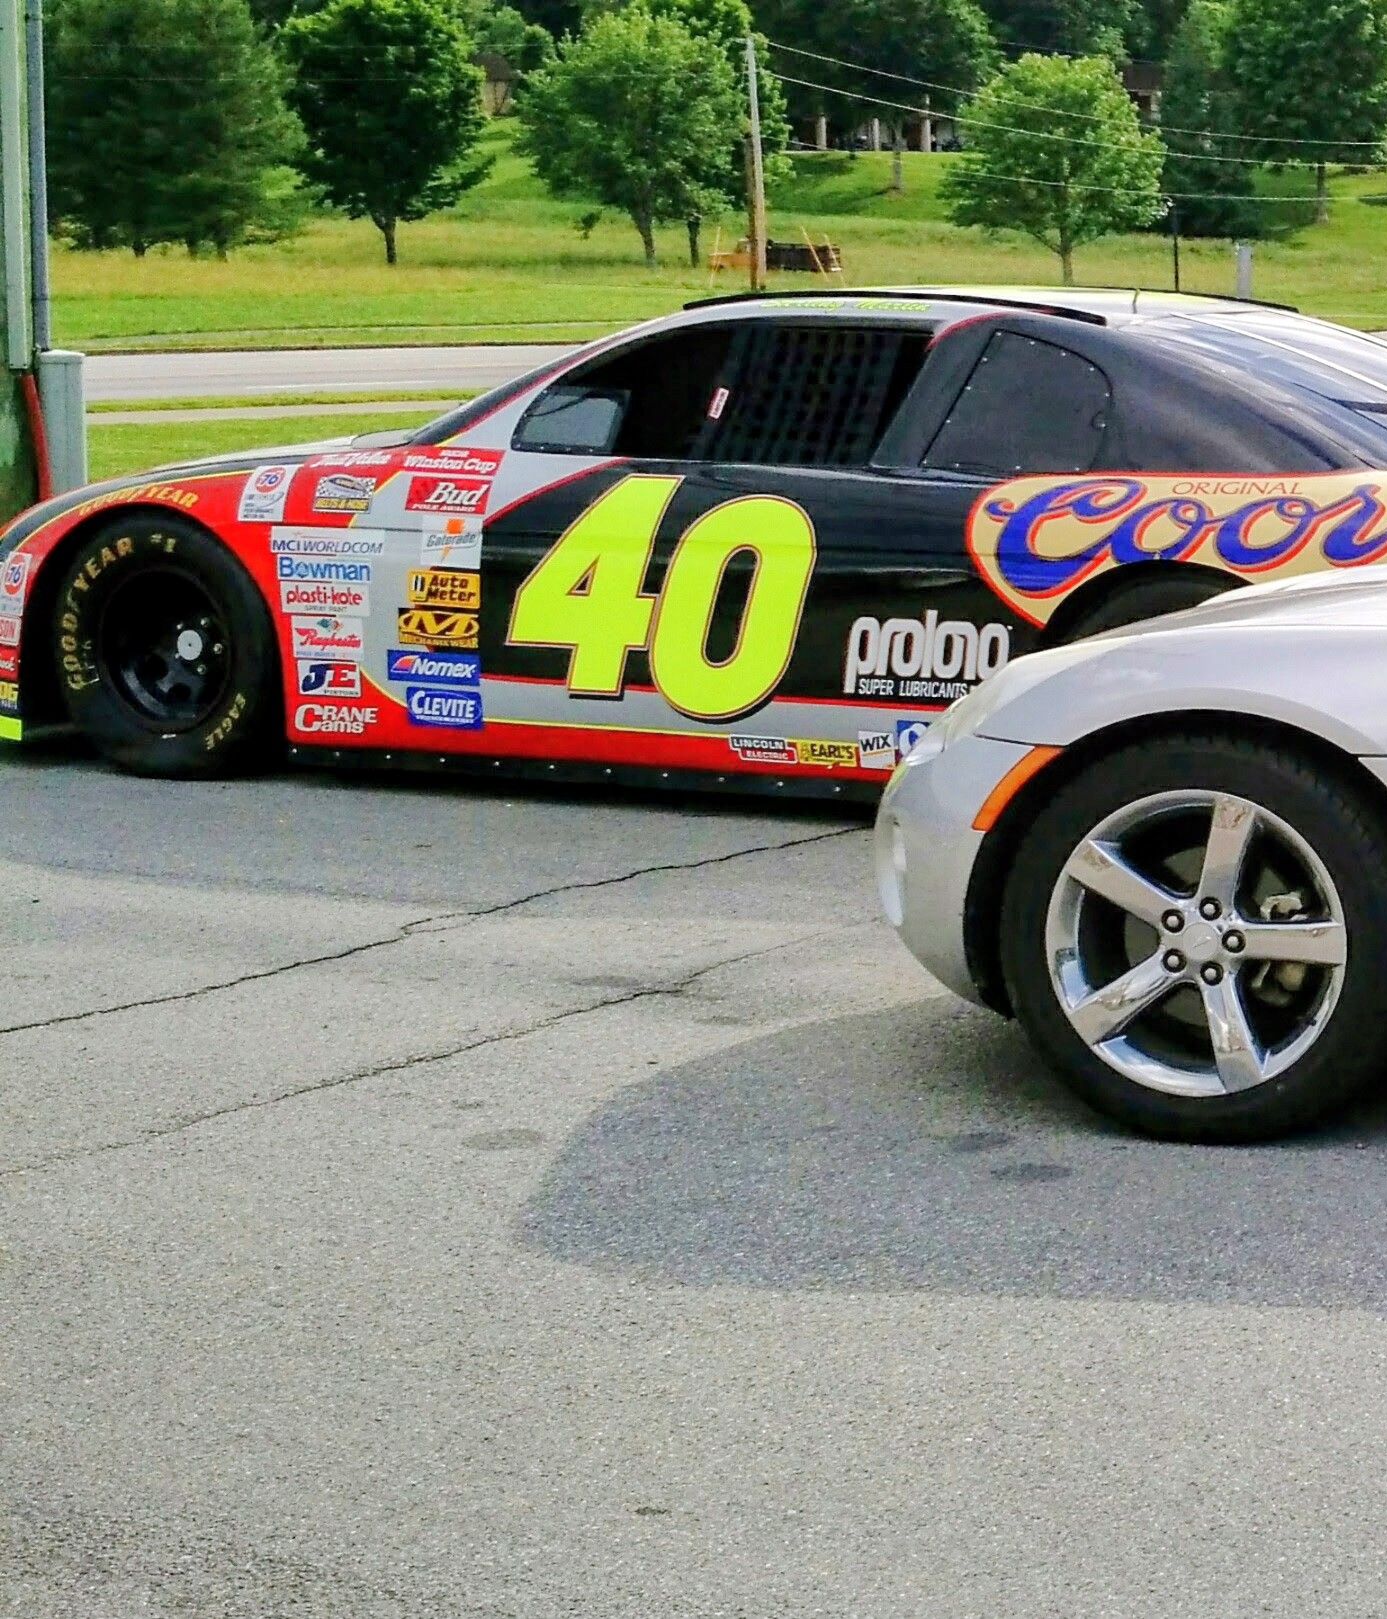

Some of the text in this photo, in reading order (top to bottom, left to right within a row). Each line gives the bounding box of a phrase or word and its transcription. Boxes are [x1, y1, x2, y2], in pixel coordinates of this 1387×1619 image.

[403, 455, 497, 473] Winston Cup
[260, 473, 279, 485] 76
[424, 482, 489, 505] Bud
[1172, 481, 1304, 497] ORIGINAL
[272, 540, 383, 554] MCI WORLDCOM
[280, 556, 371, 581] Bowman
[429, 574, 469, 589] Auto
[285, 585, 363, 606] plasti-kote
[427, 586, 476, 602] Meter
[504, 472, 818, 720] 40
[411, 657, 477, 678] Nomex
[301, 663, 357, 693] JE
[858, 678, 895, 696] SUPER
[898, 680, 969, 699] LUBRICANTS
[411, 690, 475, 718] CLEVITE
[732, 738, 784, 749] LINCOLN
[809, 742, 854, 760] EARL'S
[860, 734, 891, 752] WIX
